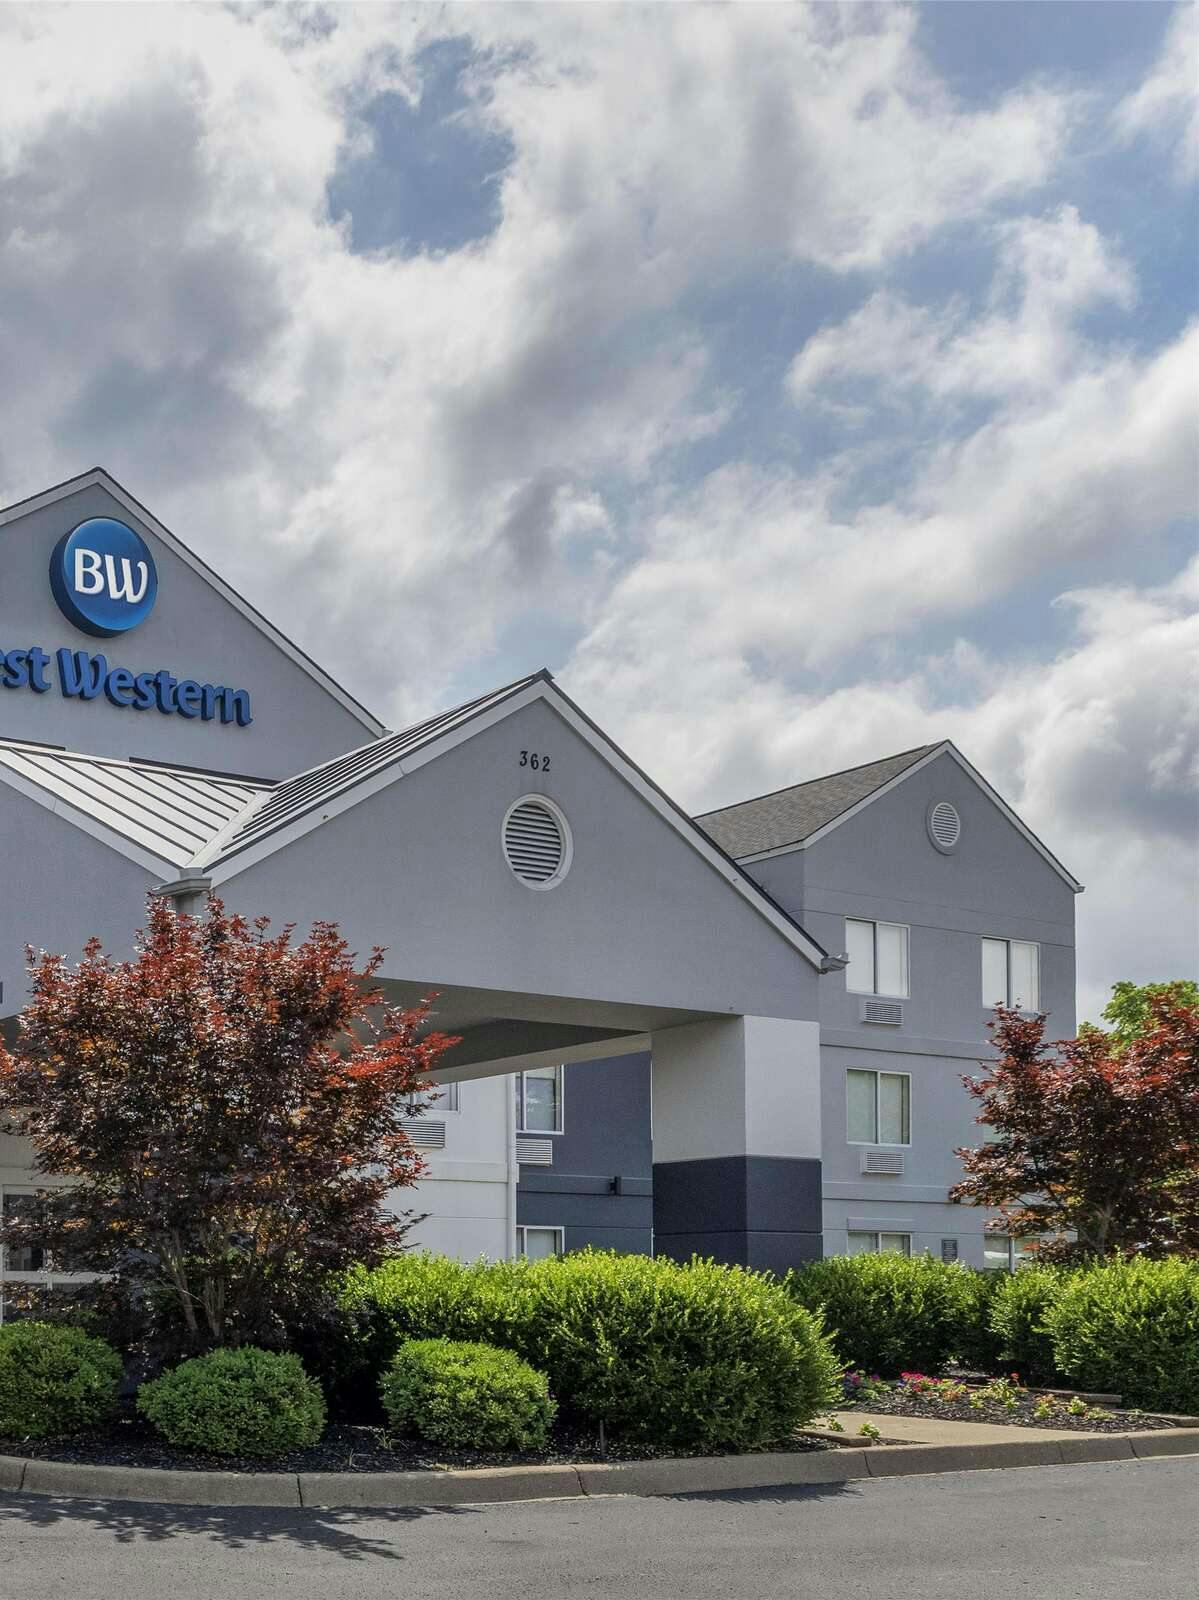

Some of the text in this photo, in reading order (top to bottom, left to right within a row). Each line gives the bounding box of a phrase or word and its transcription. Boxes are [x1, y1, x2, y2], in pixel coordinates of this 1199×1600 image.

[74, 548, 148, 603] BW
[56, 648, 253, 726] Western
[519, 750, 551, 772] 362
